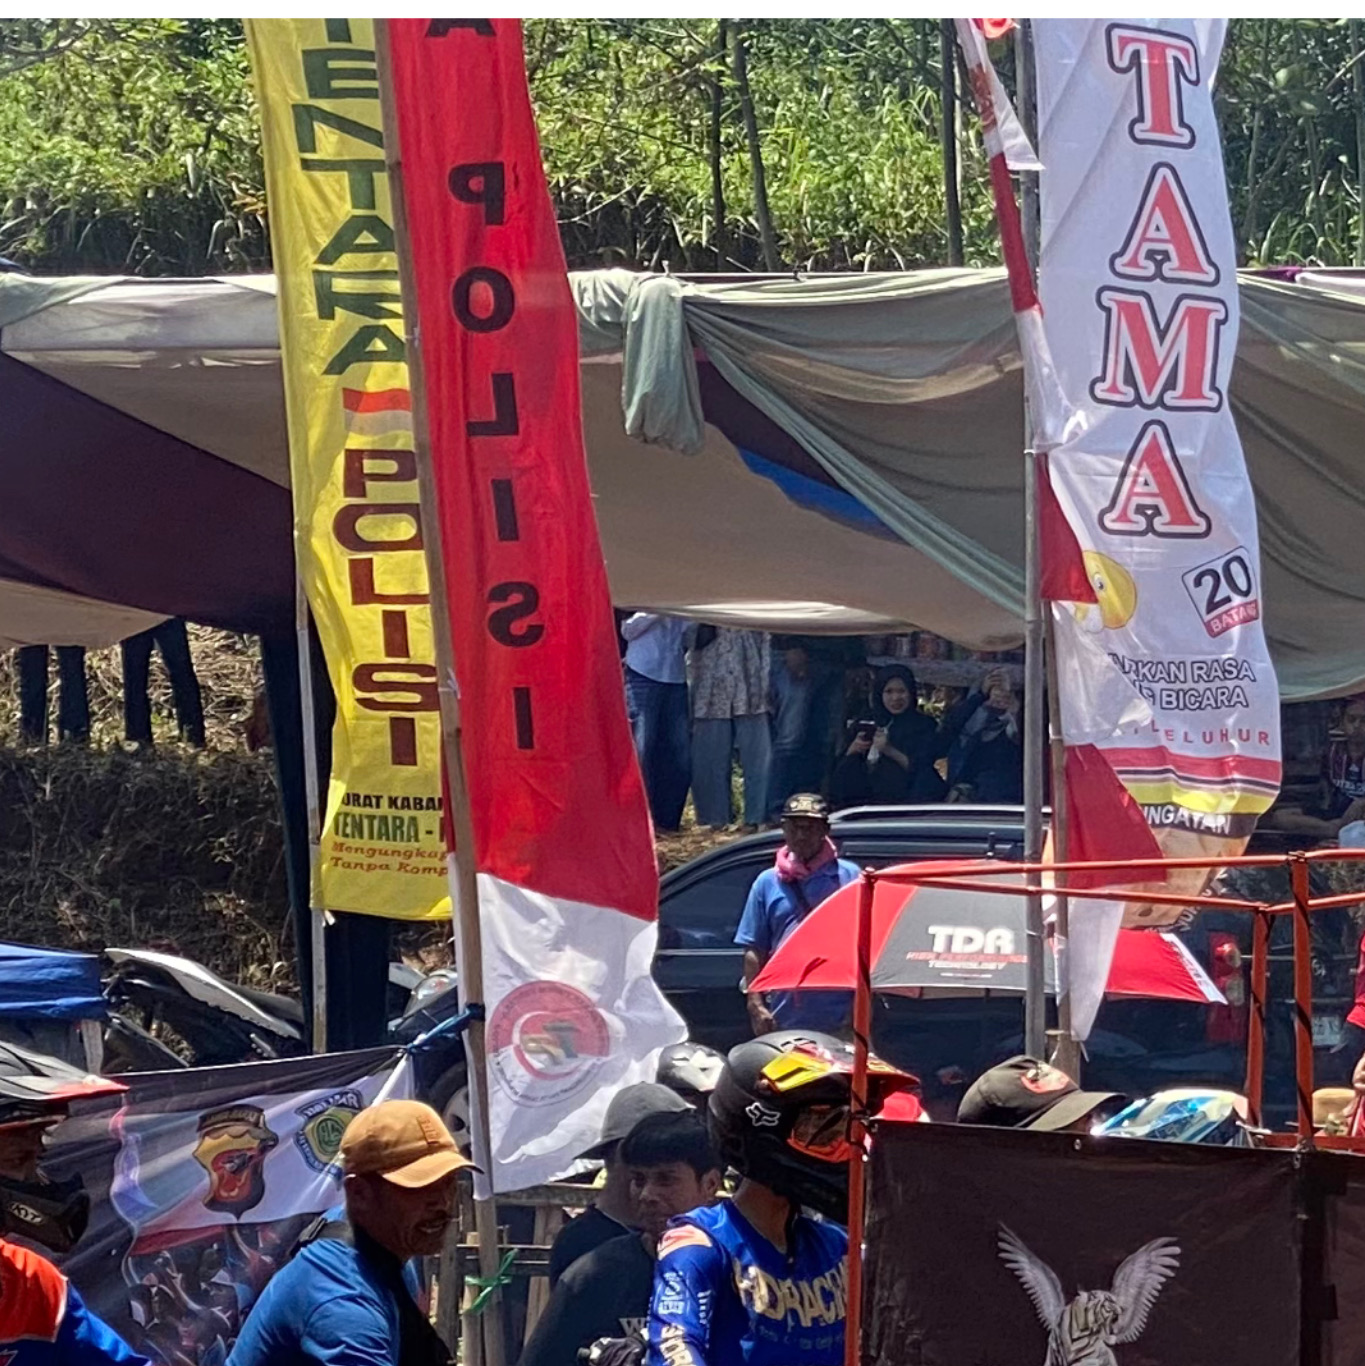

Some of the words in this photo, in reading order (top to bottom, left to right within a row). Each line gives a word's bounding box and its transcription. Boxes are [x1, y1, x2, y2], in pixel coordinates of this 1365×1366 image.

[1088, 22, 1228, 540] TAMA
[1193, 555, 1253, 615] 20
[332, 448, 441, 767] POLISI
[1190, 657, 1257, 683] RASA
[1160, 685, 1250, 711] BICARA
[341, 792, 383, 809] URAT
[330, 856, 391, 873] Tanpa
[397, 861, 449, 878] Komp
[927, 924, 1016, 954] TDR
